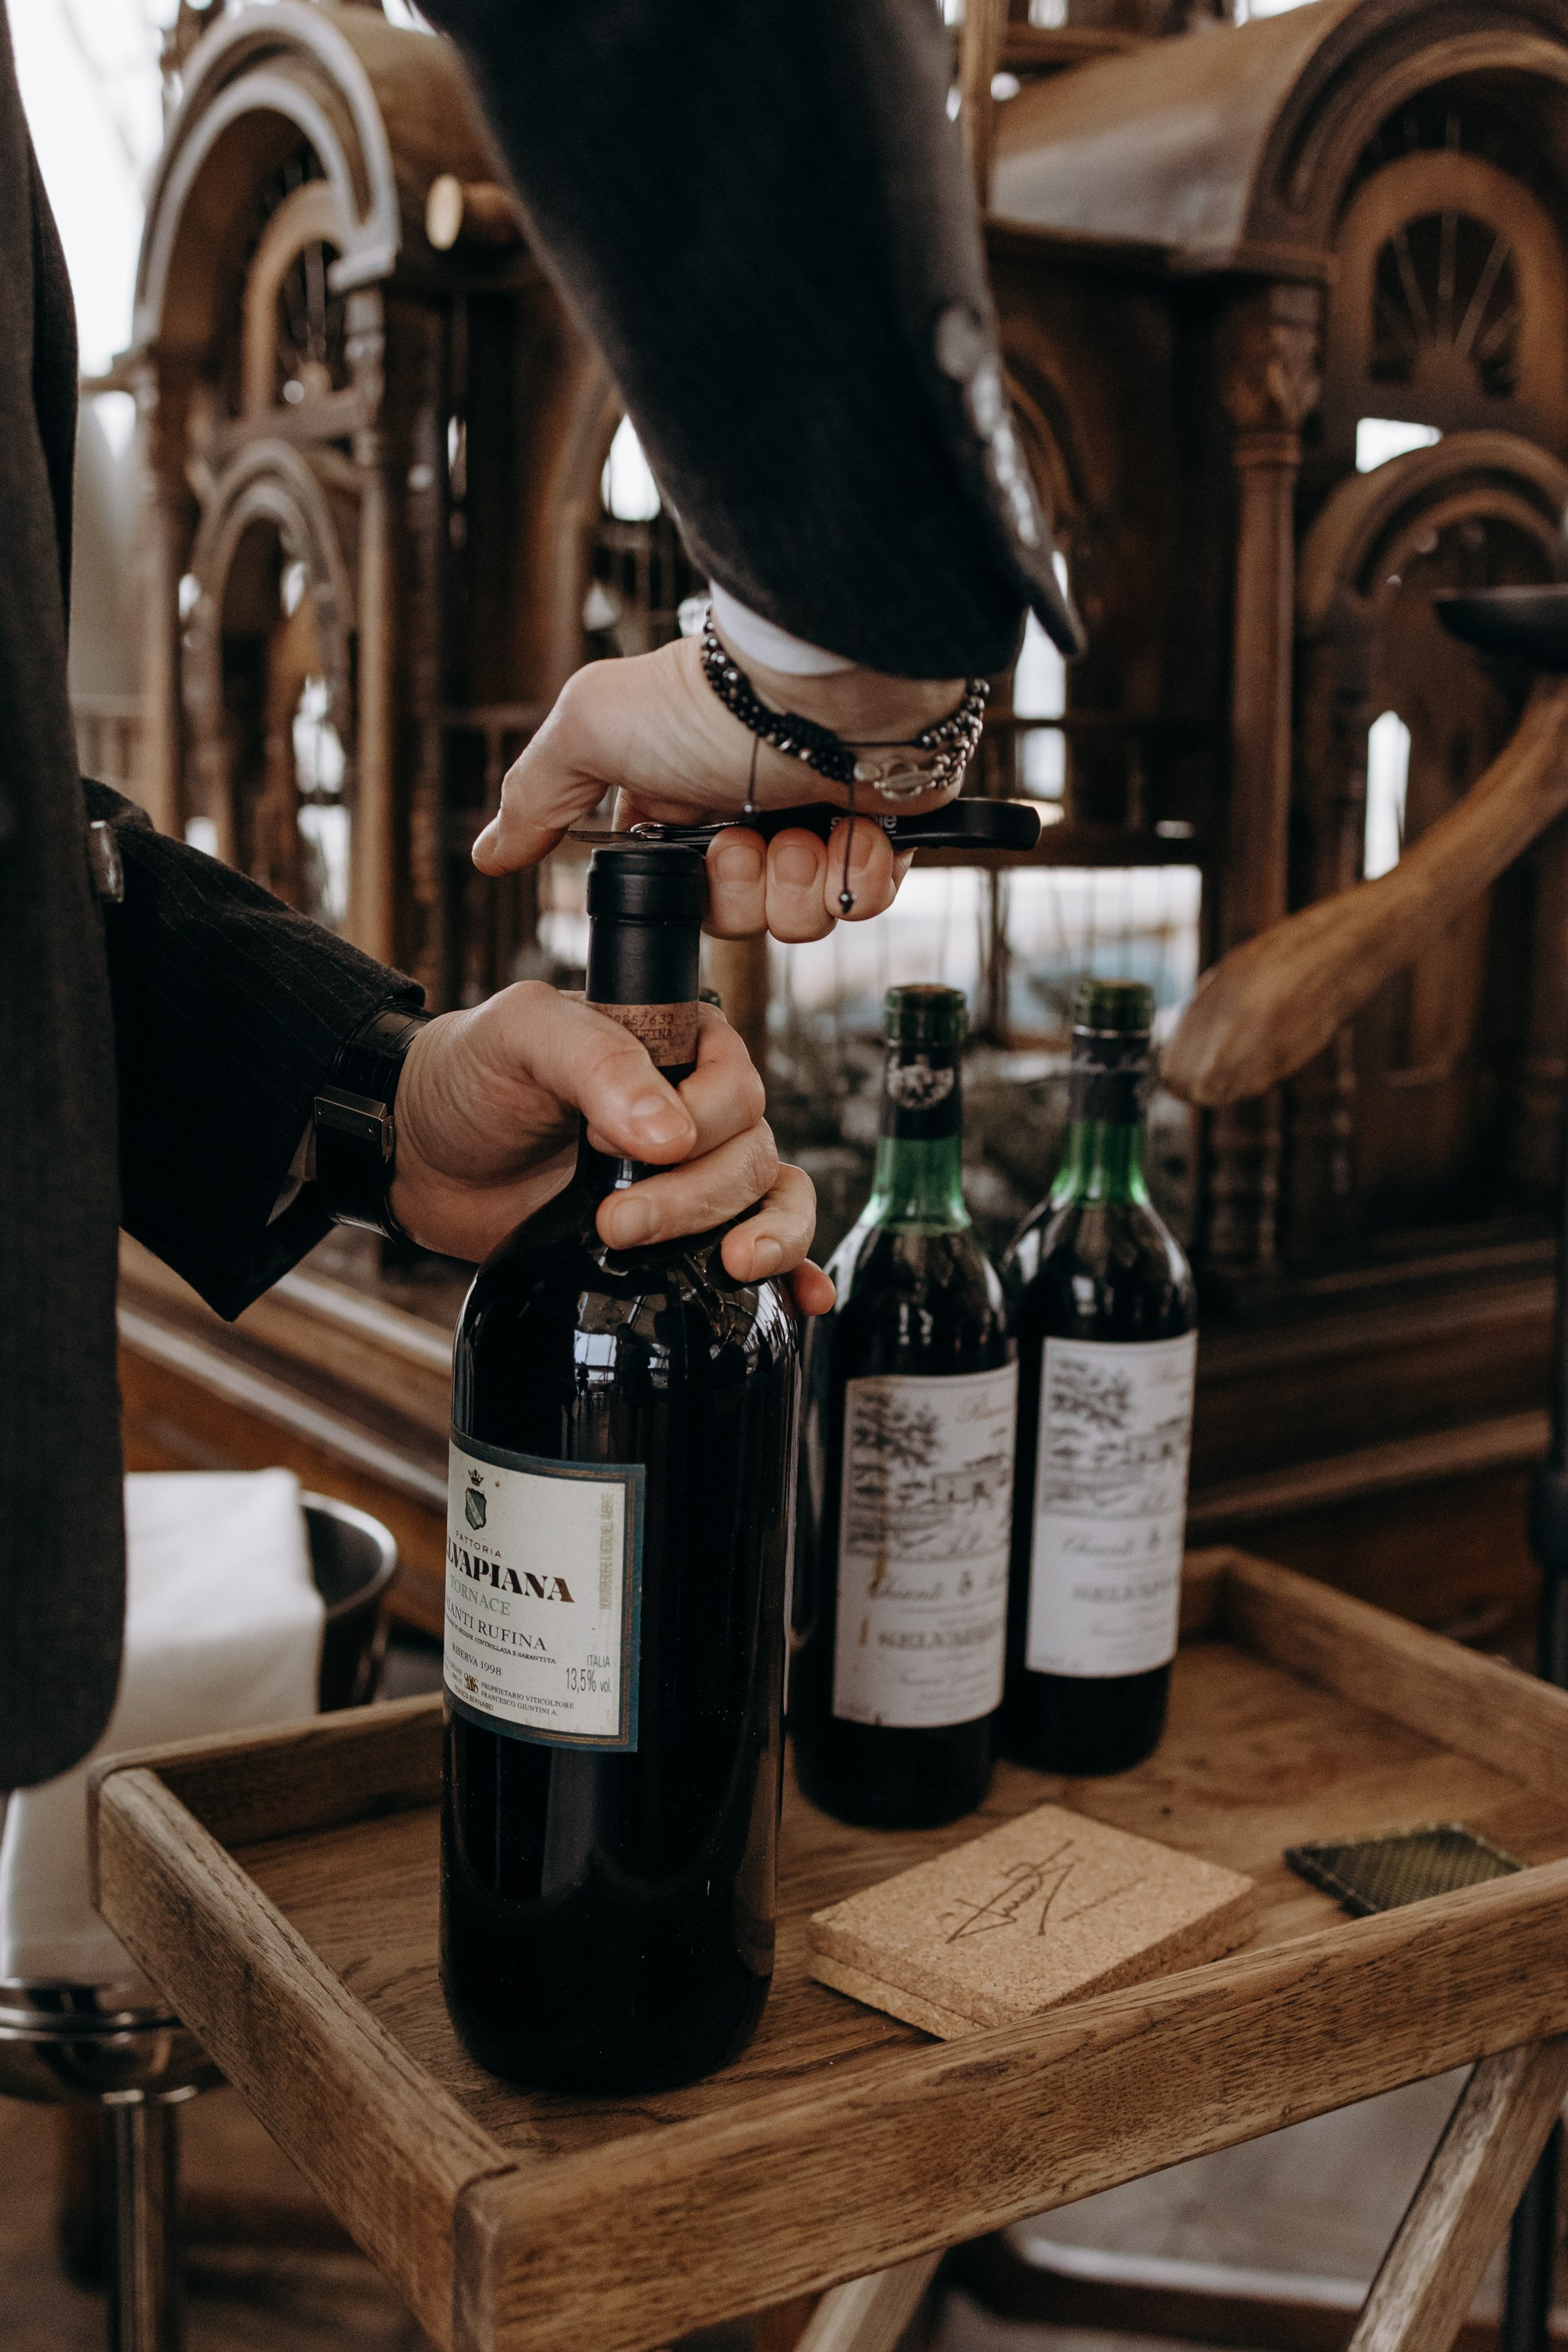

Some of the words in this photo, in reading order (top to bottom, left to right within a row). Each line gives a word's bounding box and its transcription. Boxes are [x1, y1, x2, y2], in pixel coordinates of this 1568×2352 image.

[456, 1530, 502, 1559] FATTORIA
[447, 1536, 575, 1603] LVAPIANA
[450, 1573, 511, 1617] FORNACE
[477, 1620, 548, 1652] RUFINA
[452, 1642, 479, 1668] RISERVA
[481, 1661, 503, 1676] 1998
[474, 1637, 512, 1656] CONTROLLATA
[517, 1652, 557, 1664] GARANTITA
[586, 1654, 611, 1668] ITALIA
[481, 1681, 524, 1700] PROPRIETARIO
[525, 1695, 575, 1709] VITICOLTORE
[565, 1668, 597, 1694] 13,5%
[600, 1677, 612, 1693] vol.
[454, 1683, 469, 1700] FRANCO
[469, 1694, 494, 1711] BERNABEI
[481, 1690, 516, 1708] FRANCESCO
[517, 1702, 550, 1715] GIUNTINI
